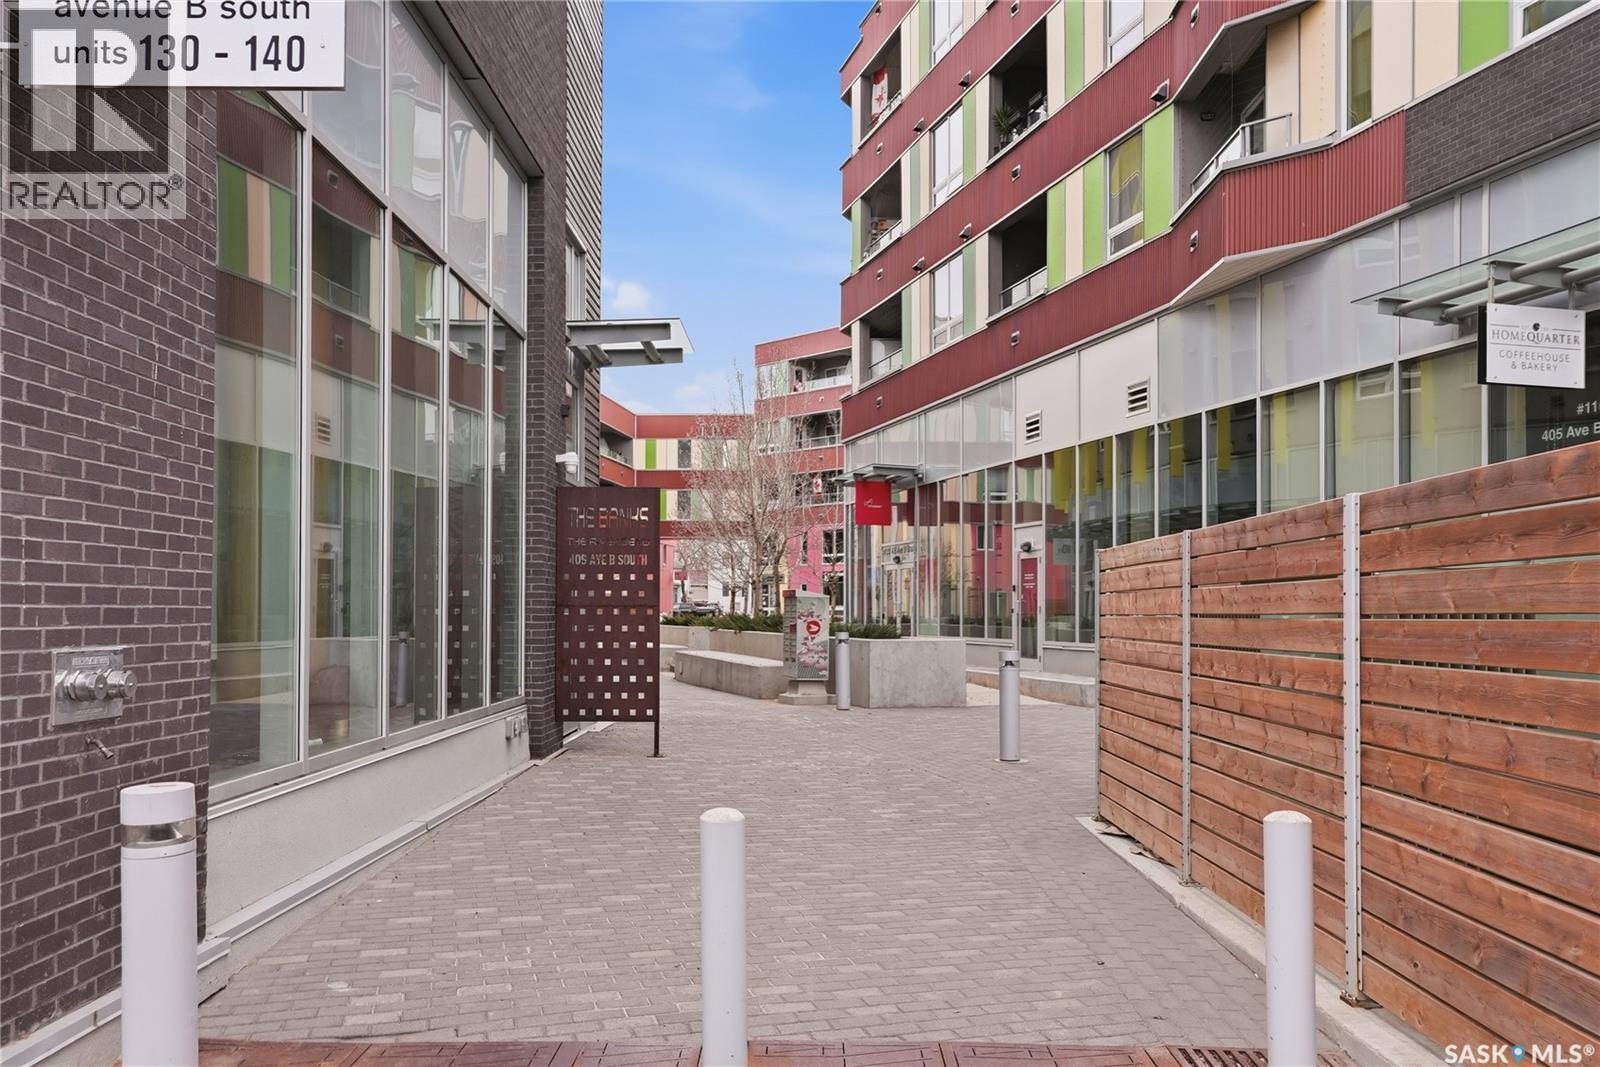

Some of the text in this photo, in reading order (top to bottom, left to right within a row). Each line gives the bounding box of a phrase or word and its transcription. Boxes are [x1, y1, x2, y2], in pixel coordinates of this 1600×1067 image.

[54, 0, 310, 19] avenue B south
[54, 40, 128, 64] units
[139, 34, 200, 71] 130
[245, 35, 305, 71] 140
[1491, 329, 1581, 345] HOMEQUARTER
[1499, 350, 1571, 363] COFFEEHOUSE
[1511, 360, 1559, 372] & BAKERY
[1576, 400, 1600, 416] #11
[1541, 428, 1564, 442] 405
[1566, 425, 1590, 439] Ave
[568, 507, 595, 528] THE
[609, 554, 616, 565] B
[618, 554, 648, 565] SOUTH
